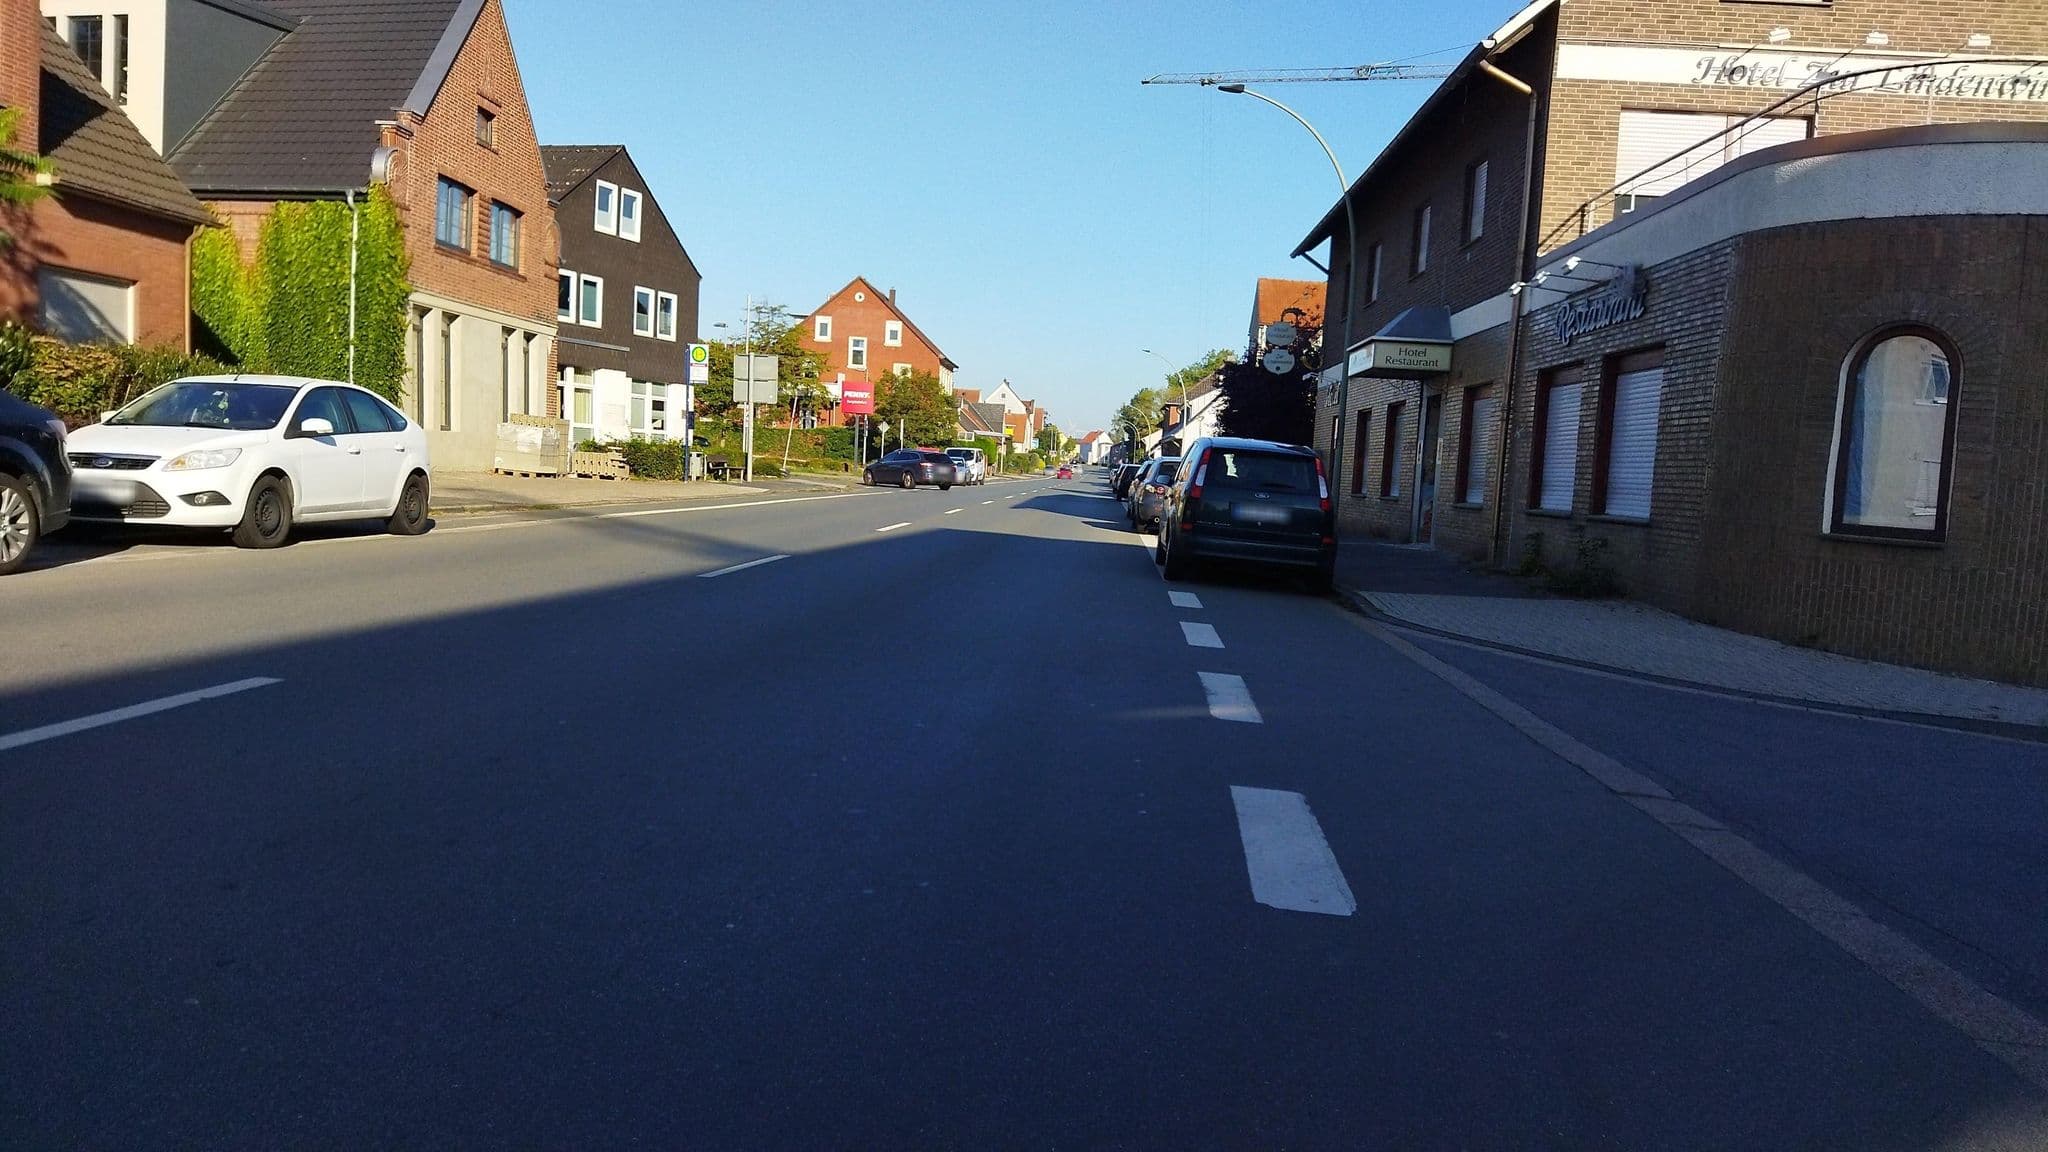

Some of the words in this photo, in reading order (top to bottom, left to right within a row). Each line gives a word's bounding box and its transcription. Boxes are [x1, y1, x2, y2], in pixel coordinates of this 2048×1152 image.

[1692, 55, 1797, 86] Hotel
[1556, 292, 1645, 346] Restaurant
[1385, 356, 1439, 367] Restaurant
[1399, 347, 1427, 357] Hotel
